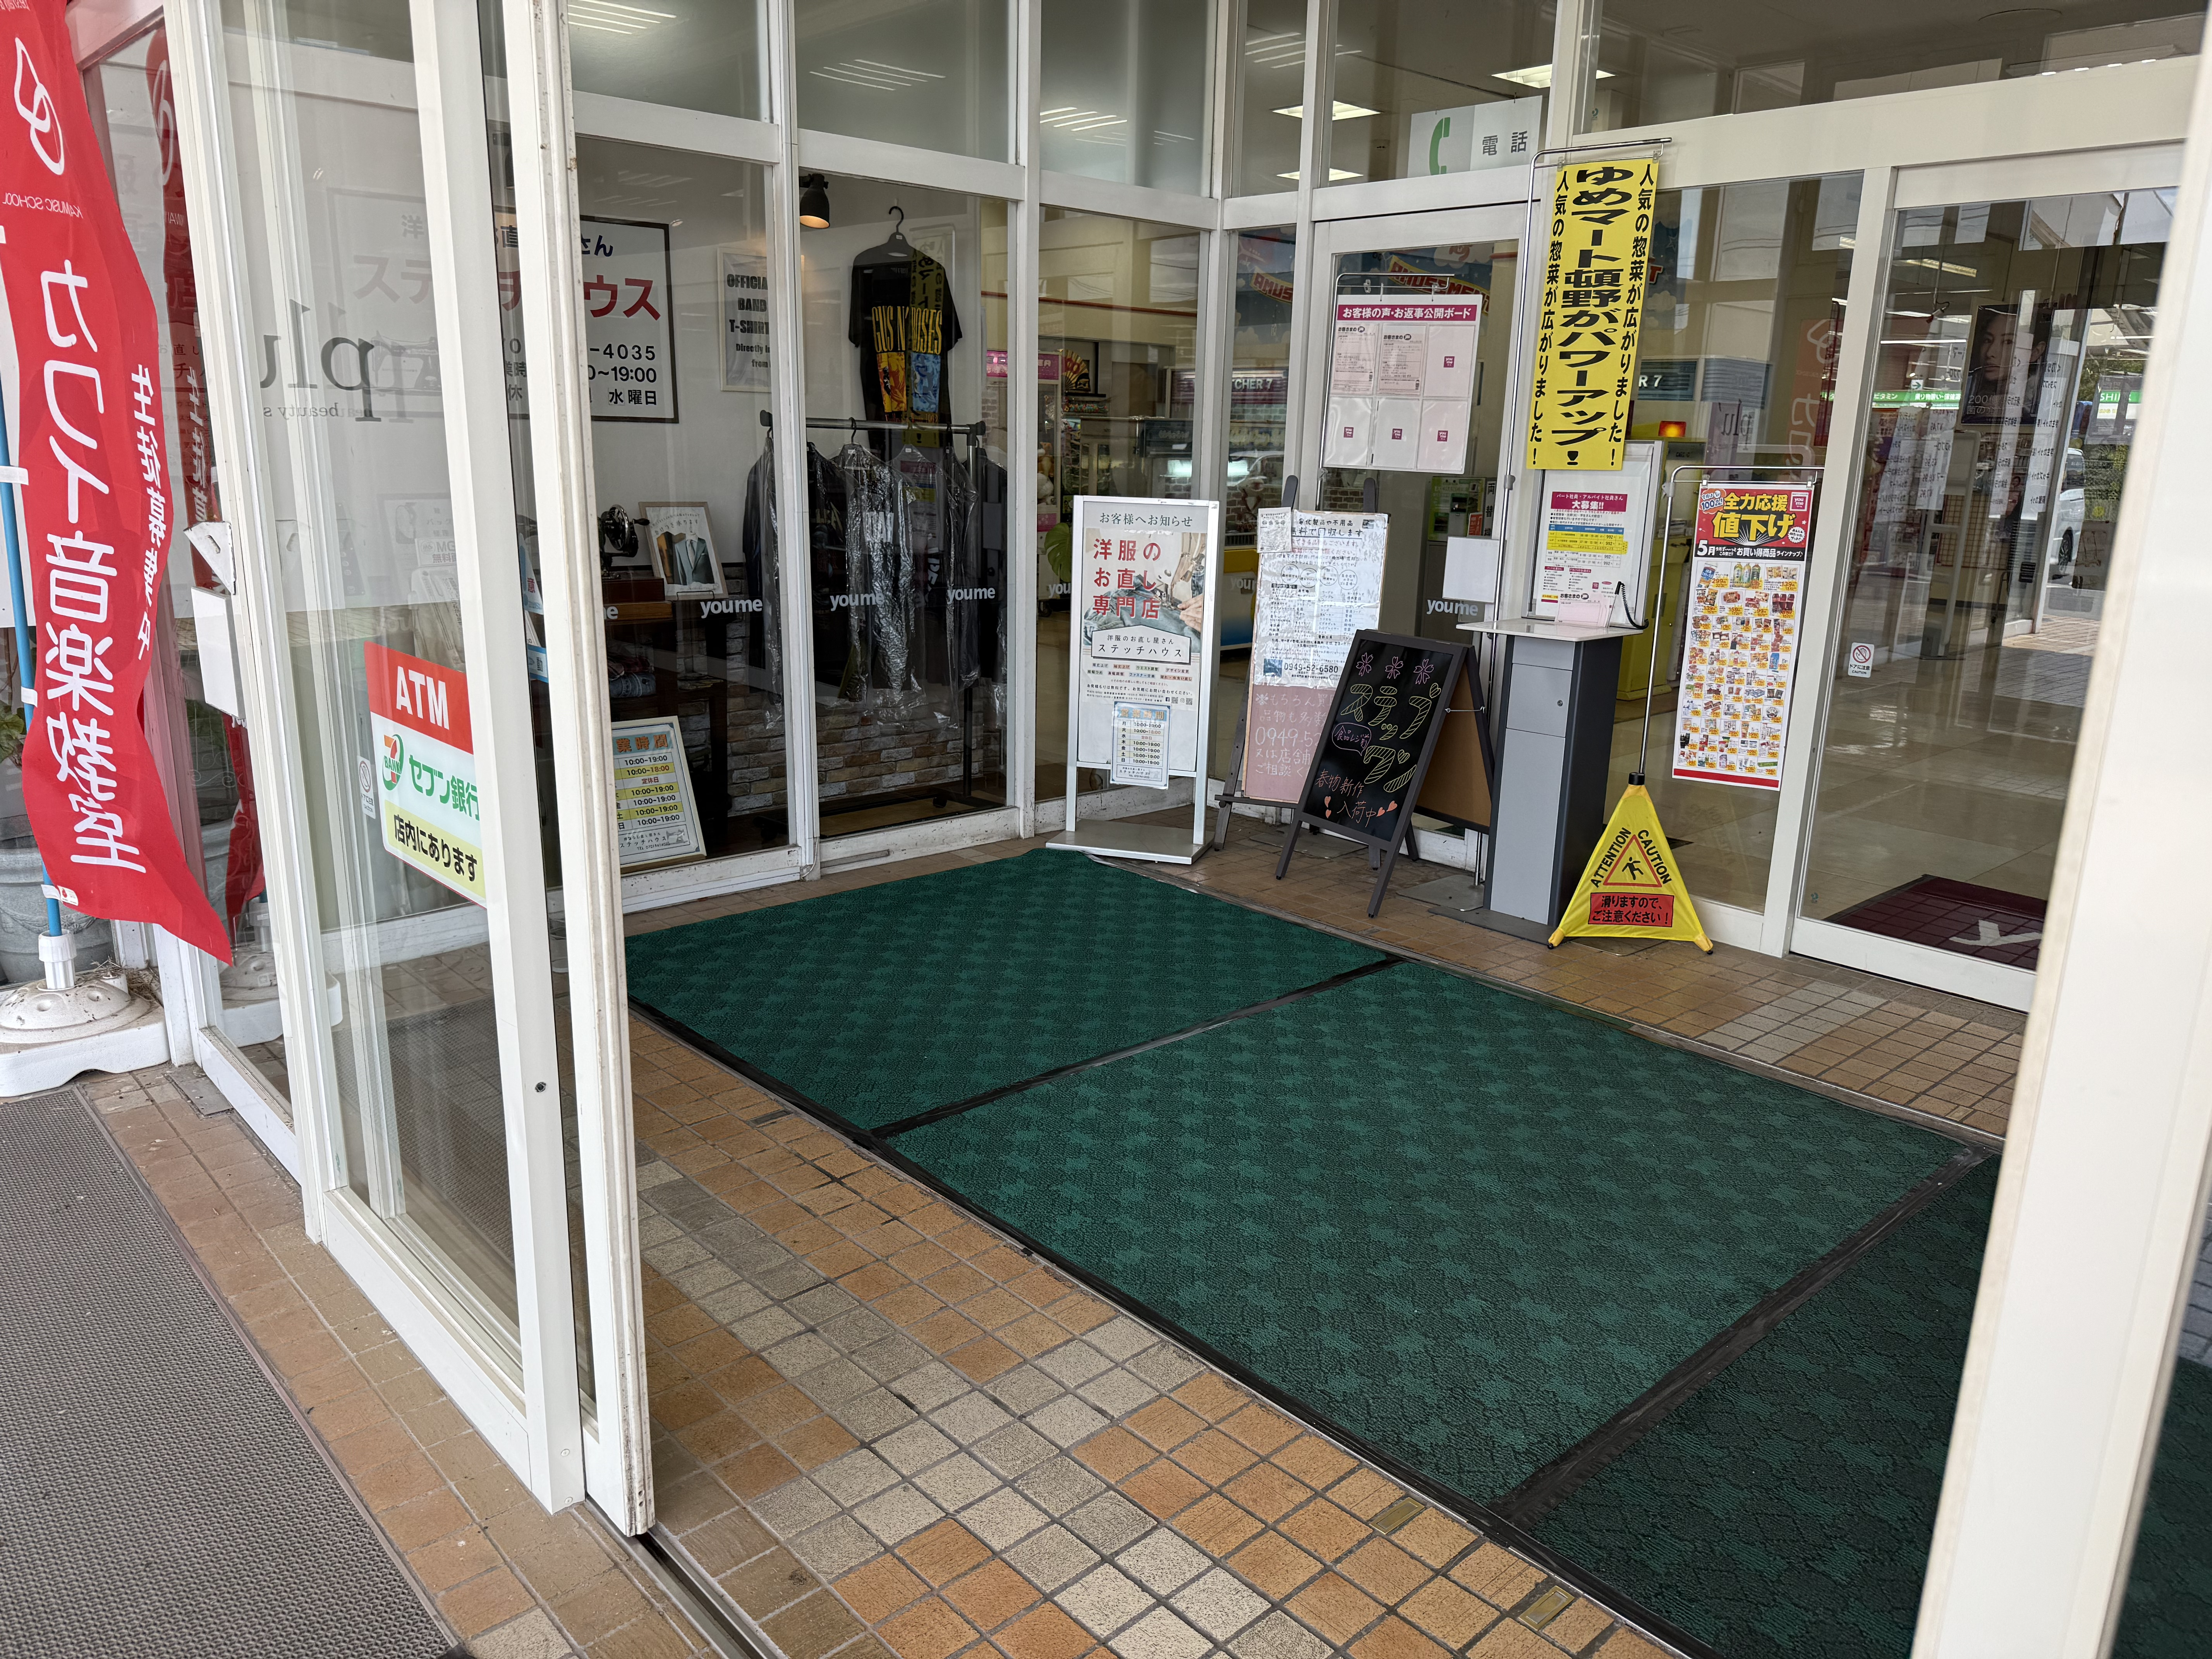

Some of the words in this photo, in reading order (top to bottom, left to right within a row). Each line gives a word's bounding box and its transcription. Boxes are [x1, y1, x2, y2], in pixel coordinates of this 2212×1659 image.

[1481, 130, 1528, 156] 電話
[738, 297, 767, 312] BAND
[1343, 307, 1471, 319] お客様の声・お返事公開ボード
[1530, 170, 1569, 465] 人気の惣菜が広がりました！
[1609, 163, 1654, 466] 人気の惣菜が広がりました！
[736, 343, 763, 354] Directly
[752, 359, 768, 368] from
[609, 388, 657, 406] 水曜日
[1572, 501, 1604, 510] 大募集!!
[1724, 492, 1788, 512] 全力応援
[1099, 513, 1193, 527] お客様へお知らせ
[1712, 512, 1796, 541] 値下げ
[1093, 538, 1161, 561] 洋服の
[1697, 540, 1716, 556] 5月
[1737, 548, 1776, 558] お買い得商品
[1094, 567, 1157, 590] お直し
[830, 594, 885, 611] youme
[947, 587, 996, 605] youme
[700, 599, 763, 619] youme
[1092, 595, 1161, 619] 専門店
[1426, 599, 1478, 616] youme
[1107, 635, 1174, 644] 洋服のお直し屋さん
[1098, 644, 1182, 657] ステッチハウス
[1284, 663, 1338, 673] 0949-52-6580
[396, 666, 450, 730] ATM
[1121, 708, 1164, 720] 営業時間
[1334, 725, 1370, 749] 食品レジ前
[384, 755, 402, 775] BANK
[625, 755, 668, 766] 10:00-19:00
[627, 765, 670, 776] 10:00-18:00
[409, 754, 480, 821] セブン銀行
[631, 785, 674, 796] 10:00-19:00
[1315, 768, 1365, 798] 春物新作
[634, 795, 676, 806] 10:00-19:00
[635, 804, 678, 816] 10:00-19:00
[1337, 801, 1377, 828] 入荷中
[637, 814, 680, 826] 10:00-19:00
[393, 814, 477, 882] 店内にあります
[620, 836, 666, 848] ステッチハウス
[1590, 827, 1632, 888] ATTENTION
[1637, 829, 1673, 884] CAUTION
[1601, 895, 1662, 910] 滑りますので、
[1592, 910, 1669, 924] ご注意ください！
